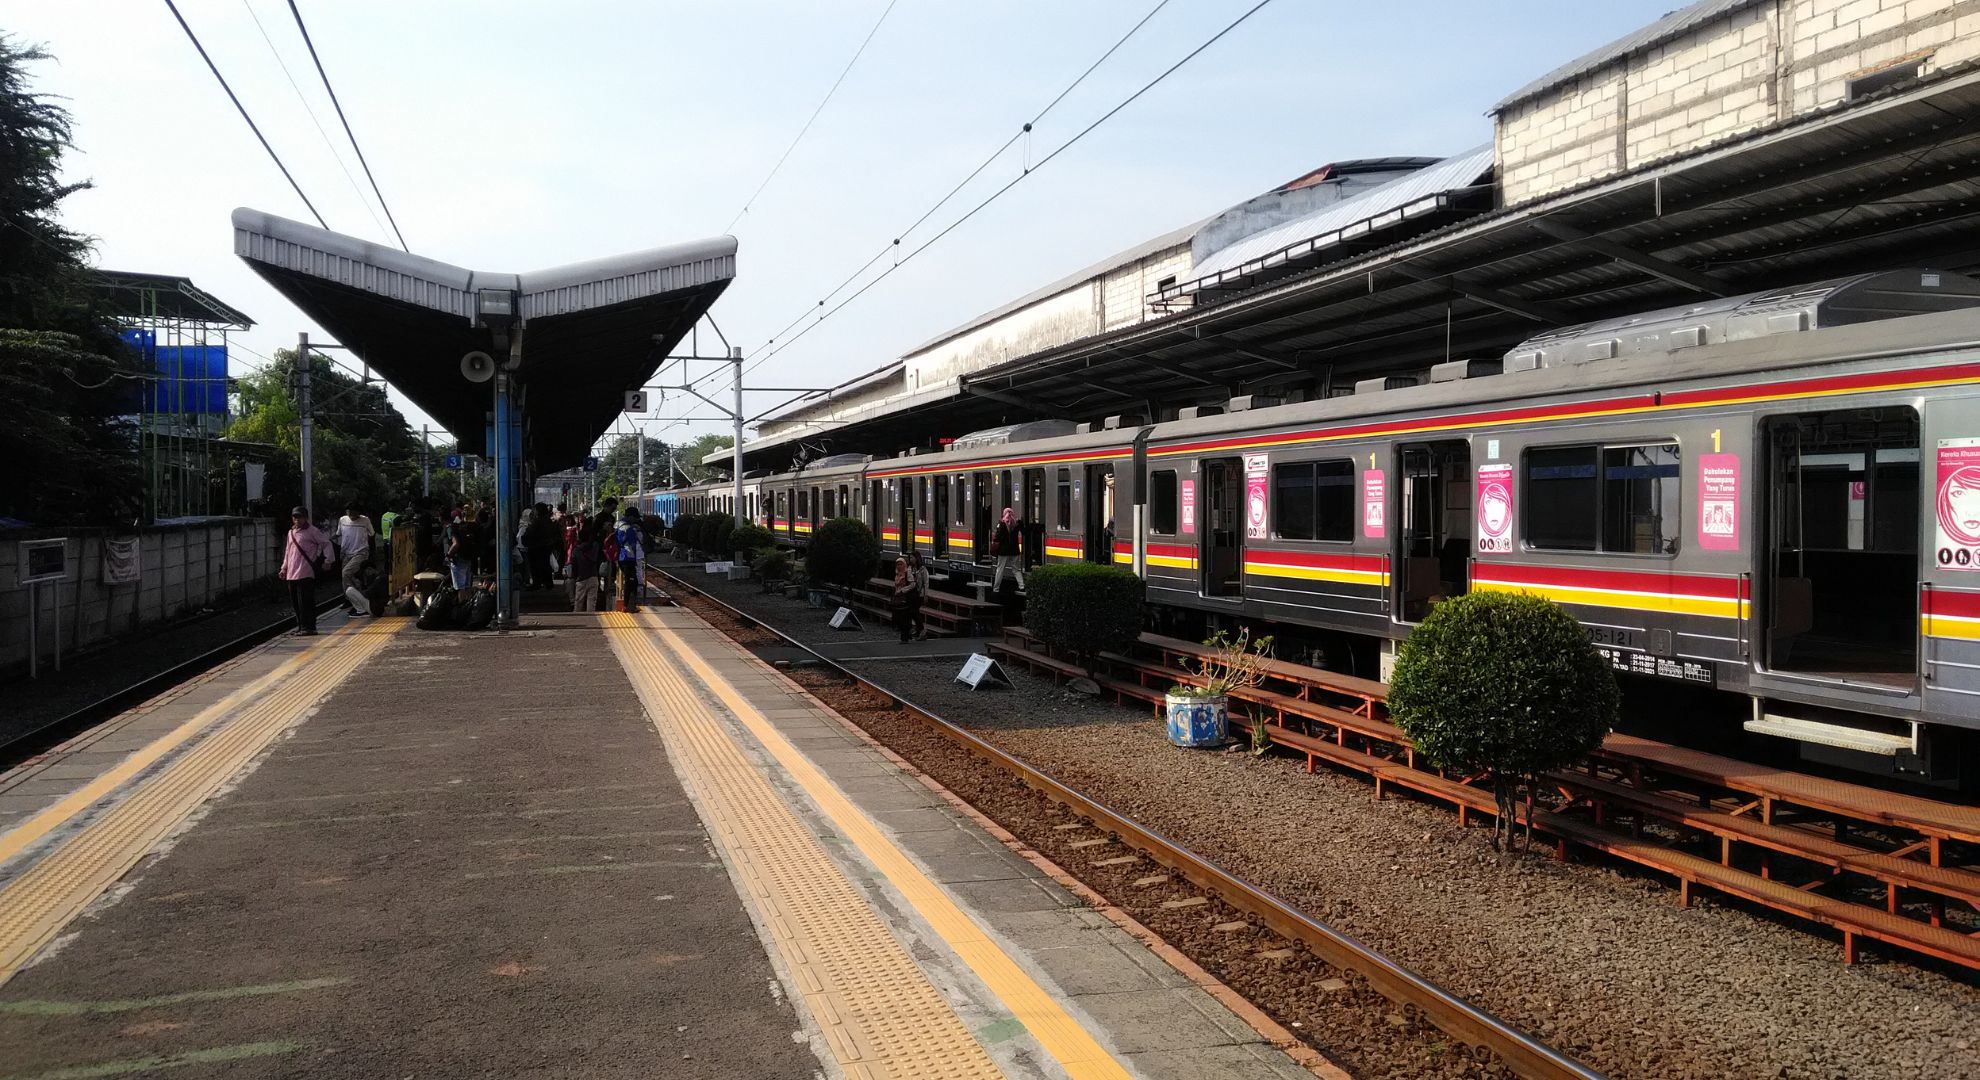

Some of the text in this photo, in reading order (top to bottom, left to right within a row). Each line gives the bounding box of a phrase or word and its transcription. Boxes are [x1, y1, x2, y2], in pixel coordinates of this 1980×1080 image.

[631, 394, 642, 409] 2
[1710, 429, 1721, 453] 1
[450, 457, 457, 467] 3
[587, 460, 594, 470] 2
[1369, 452, 1376, 470] 1
[1706, 484, 1719, 493] Yang
[1600, 649, 1610, 658] KG
